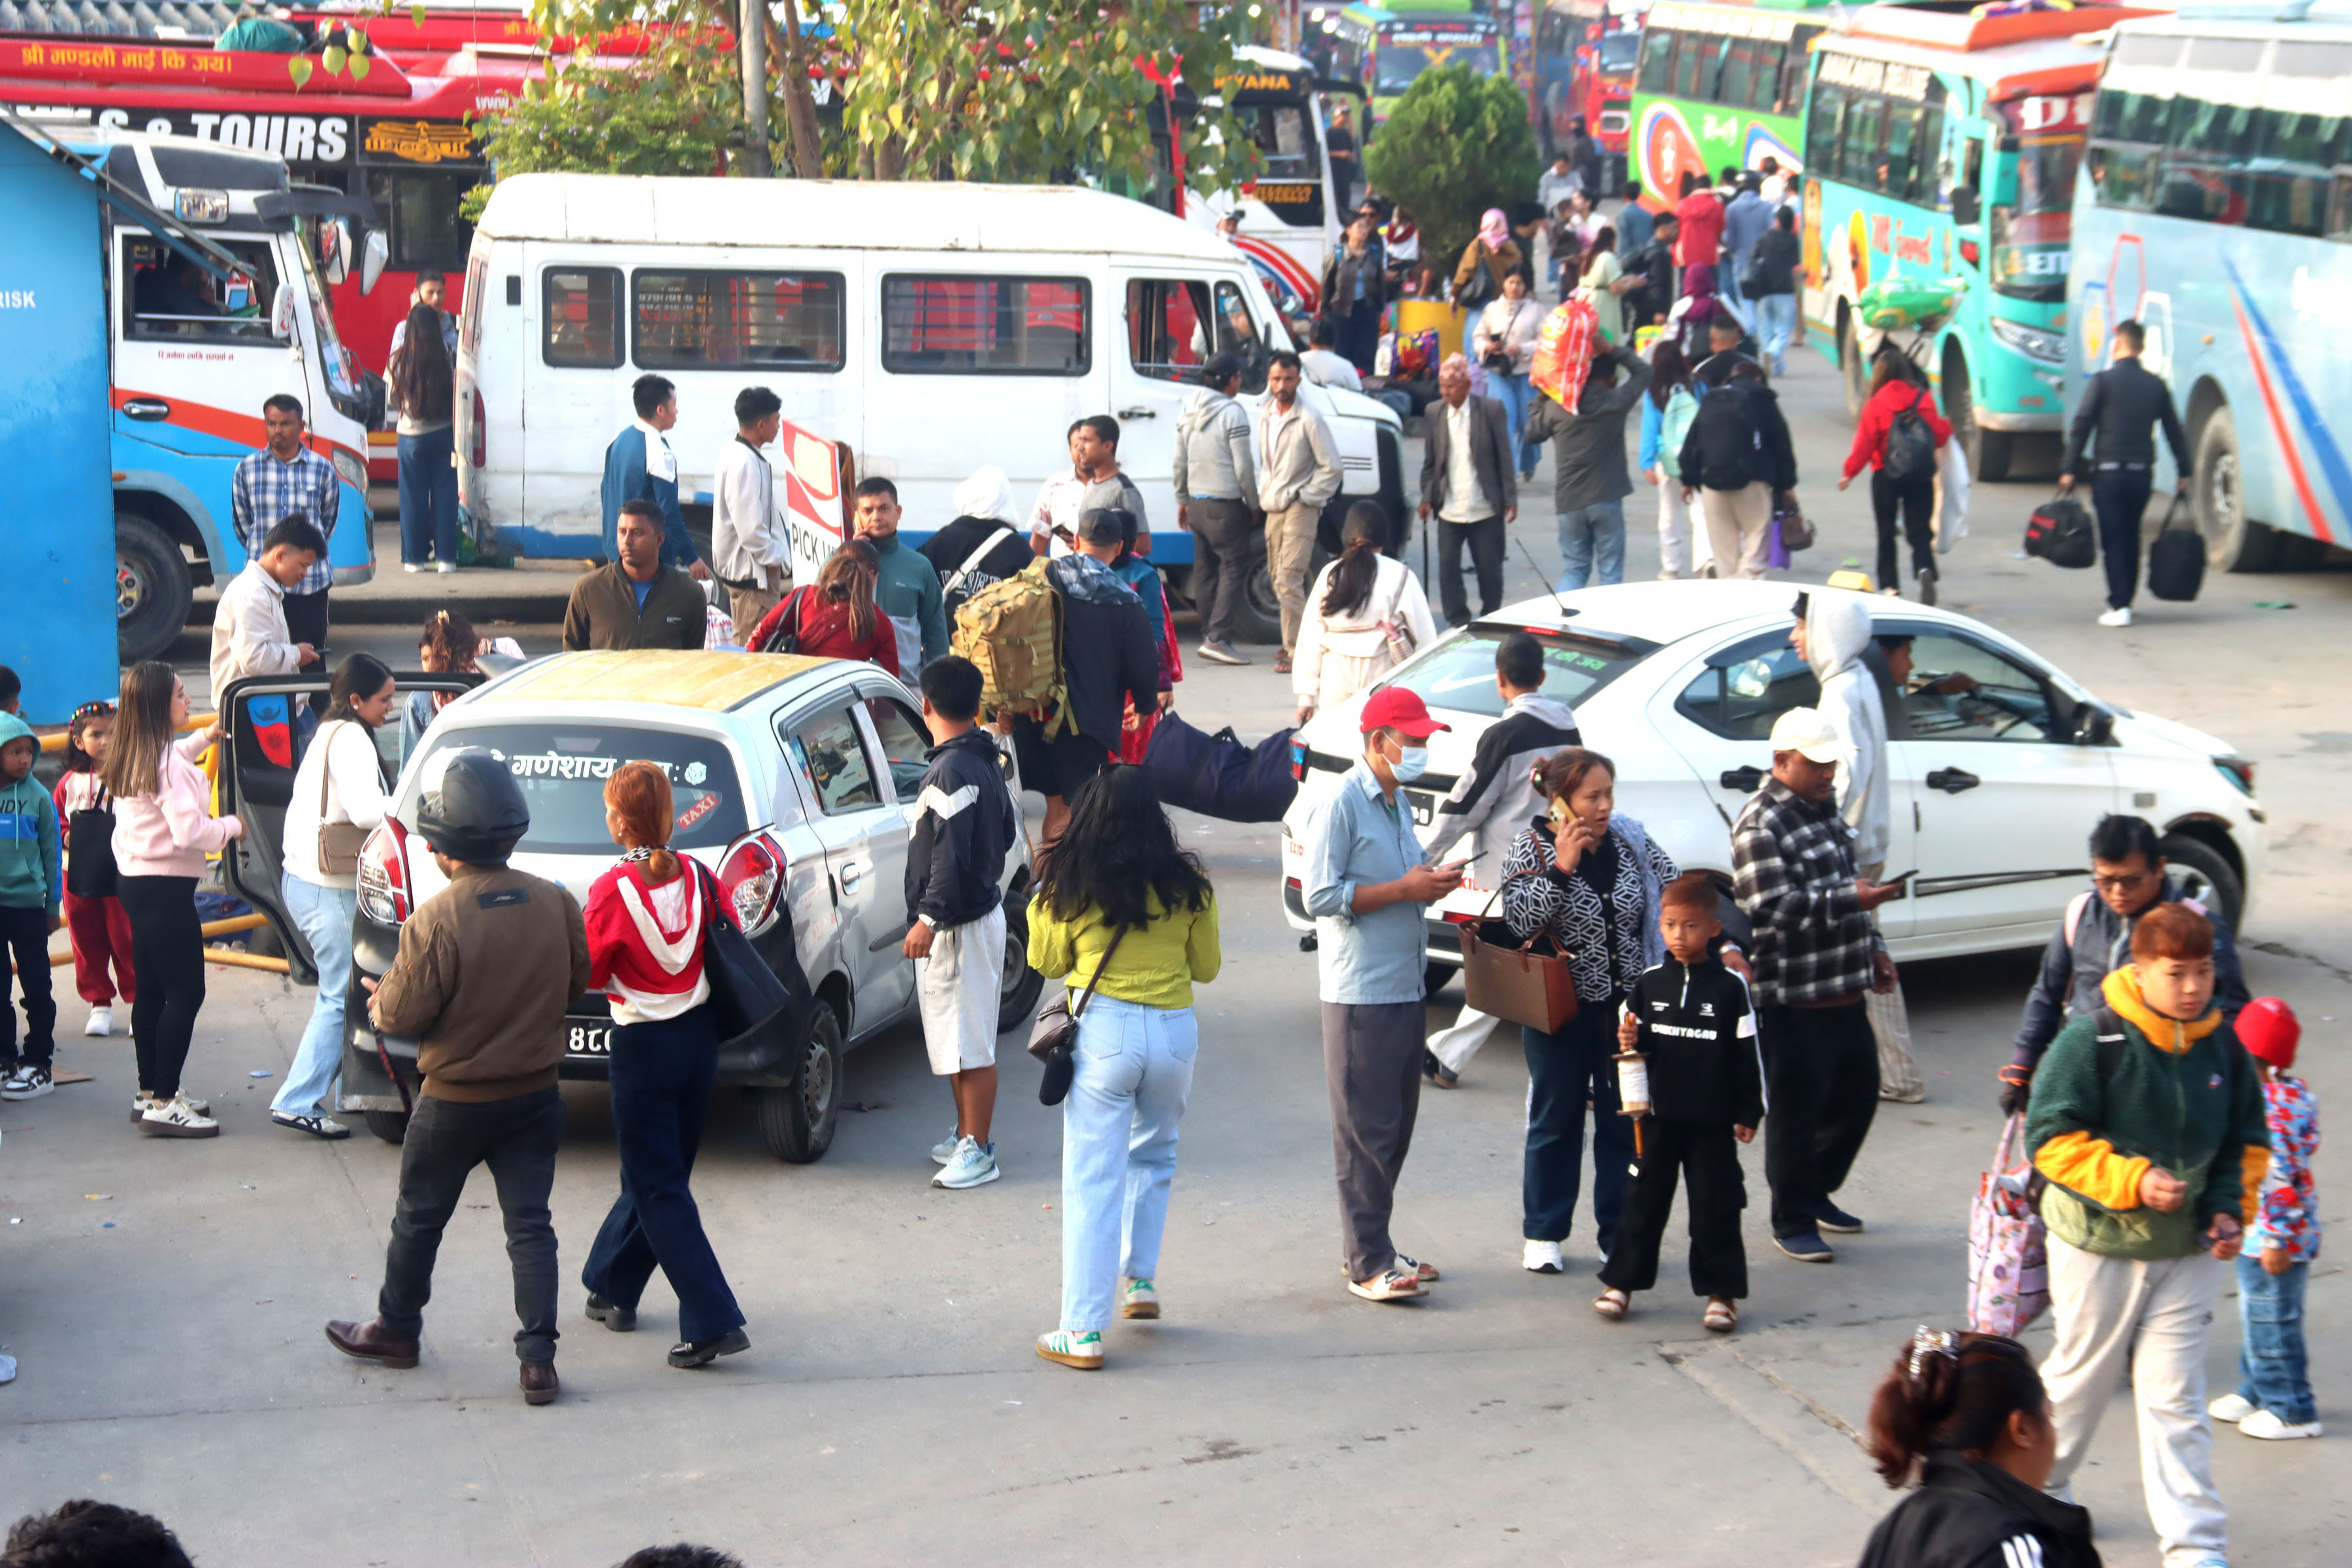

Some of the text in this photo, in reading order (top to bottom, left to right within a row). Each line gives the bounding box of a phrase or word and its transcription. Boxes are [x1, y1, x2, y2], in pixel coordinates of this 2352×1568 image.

[191, 114, 348, 161] TOURS
[792, 521, 820, 568] PICK
[512, 750, 617, 779] गणेशाय
[679, 796, 716, 827] TAXI
[1290, 841, 1305, 857] EXID
